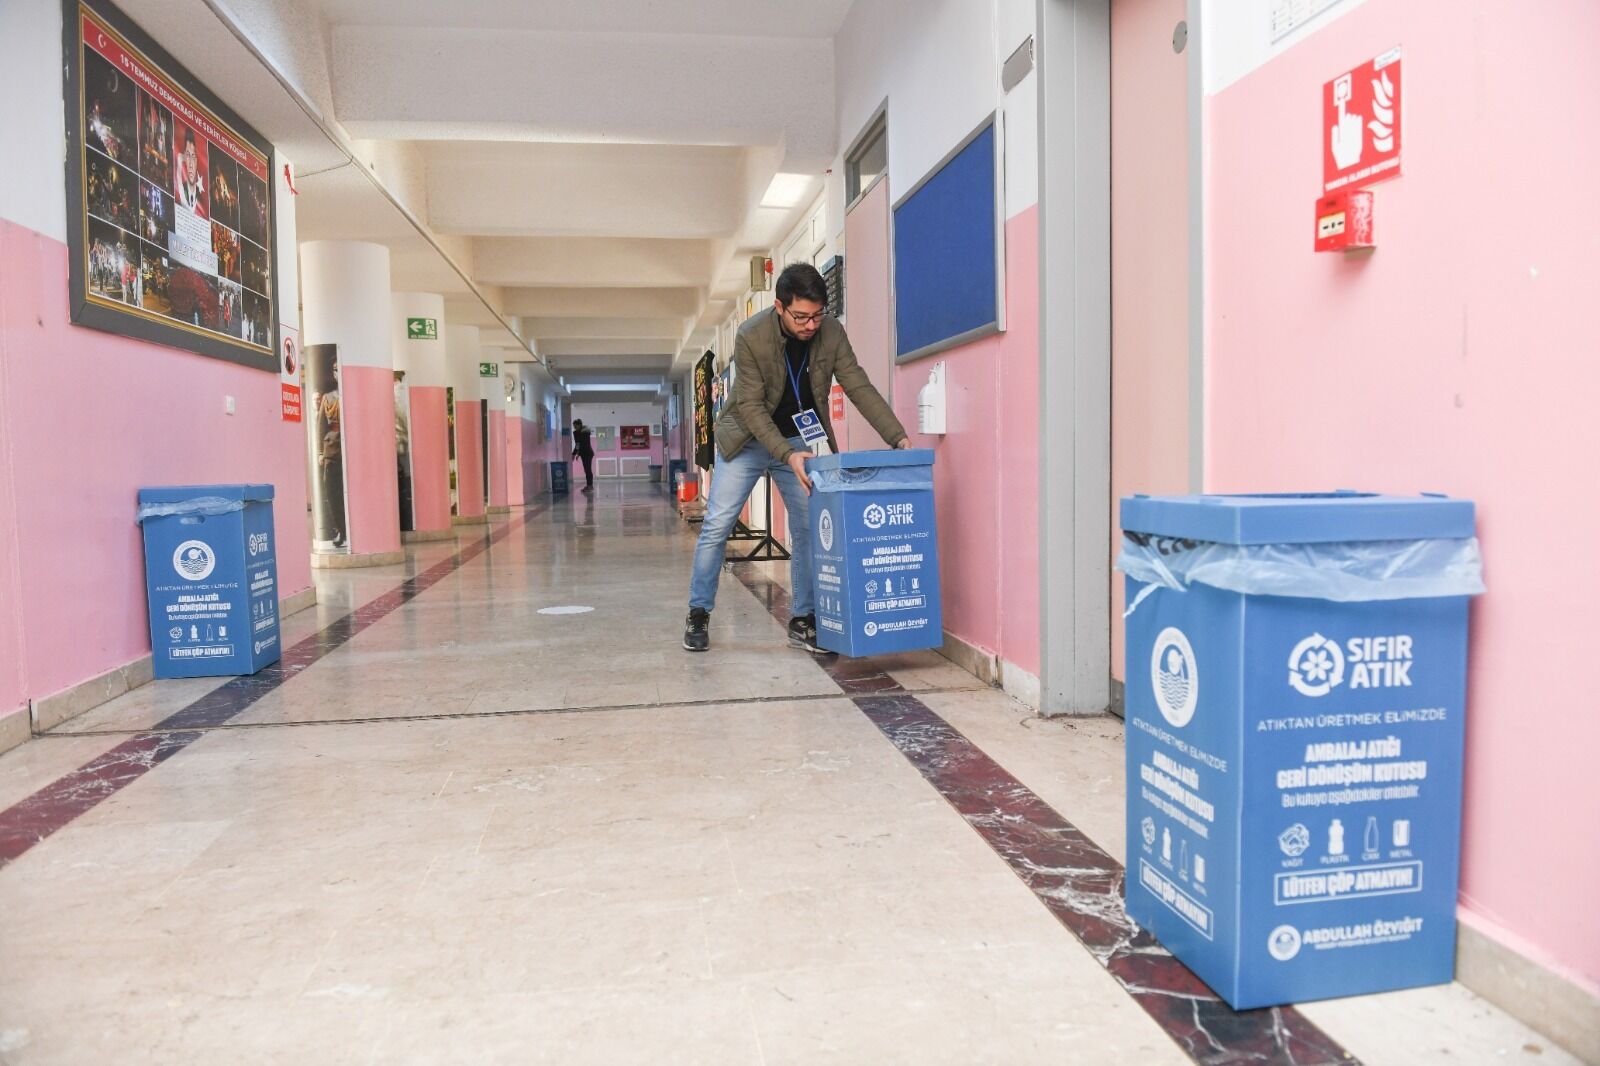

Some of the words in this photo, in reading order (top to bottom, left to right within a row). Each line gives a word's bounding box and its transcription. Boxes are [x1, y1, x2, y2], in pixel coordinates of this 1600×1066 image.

[130, 62, 159, 92] TEMMUZ
[194, 115, 203, 127] VE
[887, 503, 913, 515] SIFIR
[888, 514, 914, 526] ATIK
[1347, 635, 1413, 662] SIFIR
[1350, 661, 1413, 689] ATIK
[1257, 717, 1314, 732] ATIKTAN
[1317, 711, 1381, 728] ÜRETMEK
[1305, 740, 1367, 762] AMBALAJ
[1367, 736, 1401, 758] ATIĞI
[1277, 766, 1307, 789] GERİ
[1308, 762, 1373, 787] DÖNÜŞÜM
[1374, 761, 1427, 783] KUTUSU
[1283, 874, 1327, 897] LÜTFEN
[1328, 871, 1355, 896] ÇÖP
[1303, 924, 1372, 944] ABDULLAH
